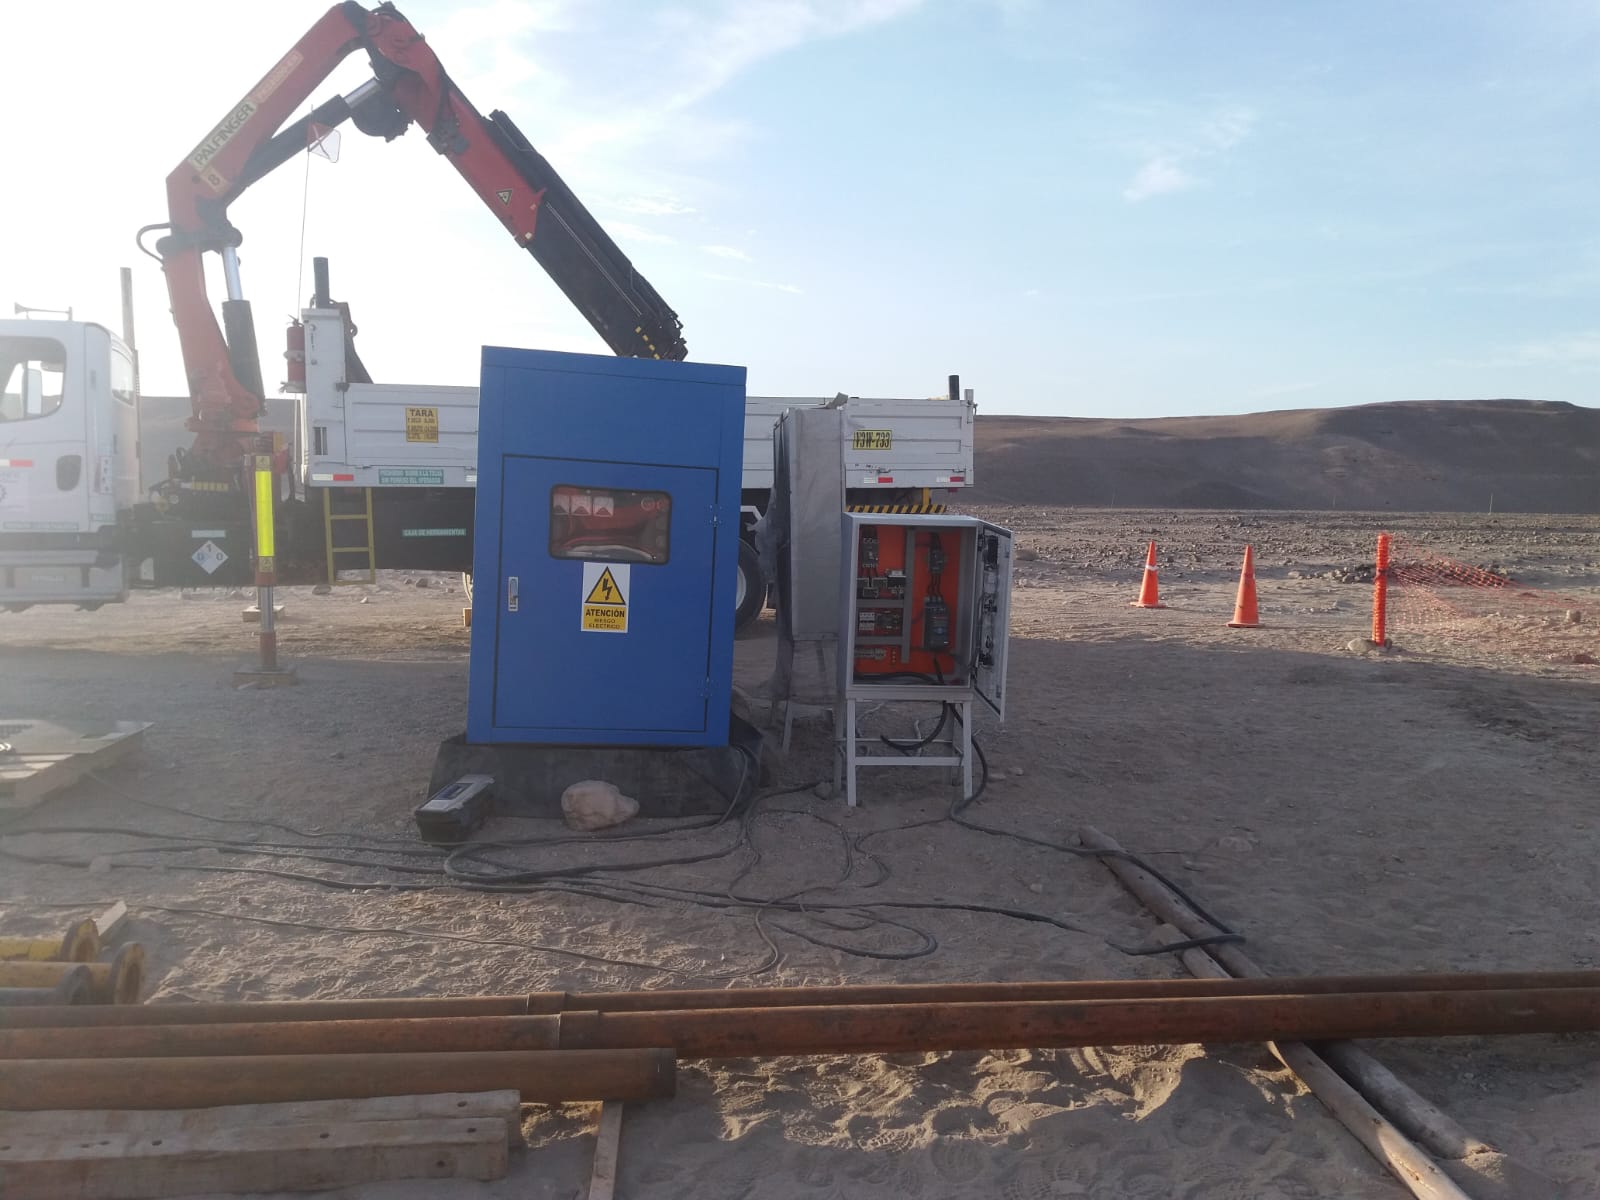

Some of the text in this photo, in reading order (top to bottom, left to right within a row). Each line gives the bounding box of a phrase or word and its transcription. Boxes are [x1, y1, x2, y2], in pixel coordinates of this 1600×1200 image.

[194, 102, 255, 166] PALFINGER
[409, 408, 434, 417] TARA
[585, 608, 625, 617] ATENCIÓN
